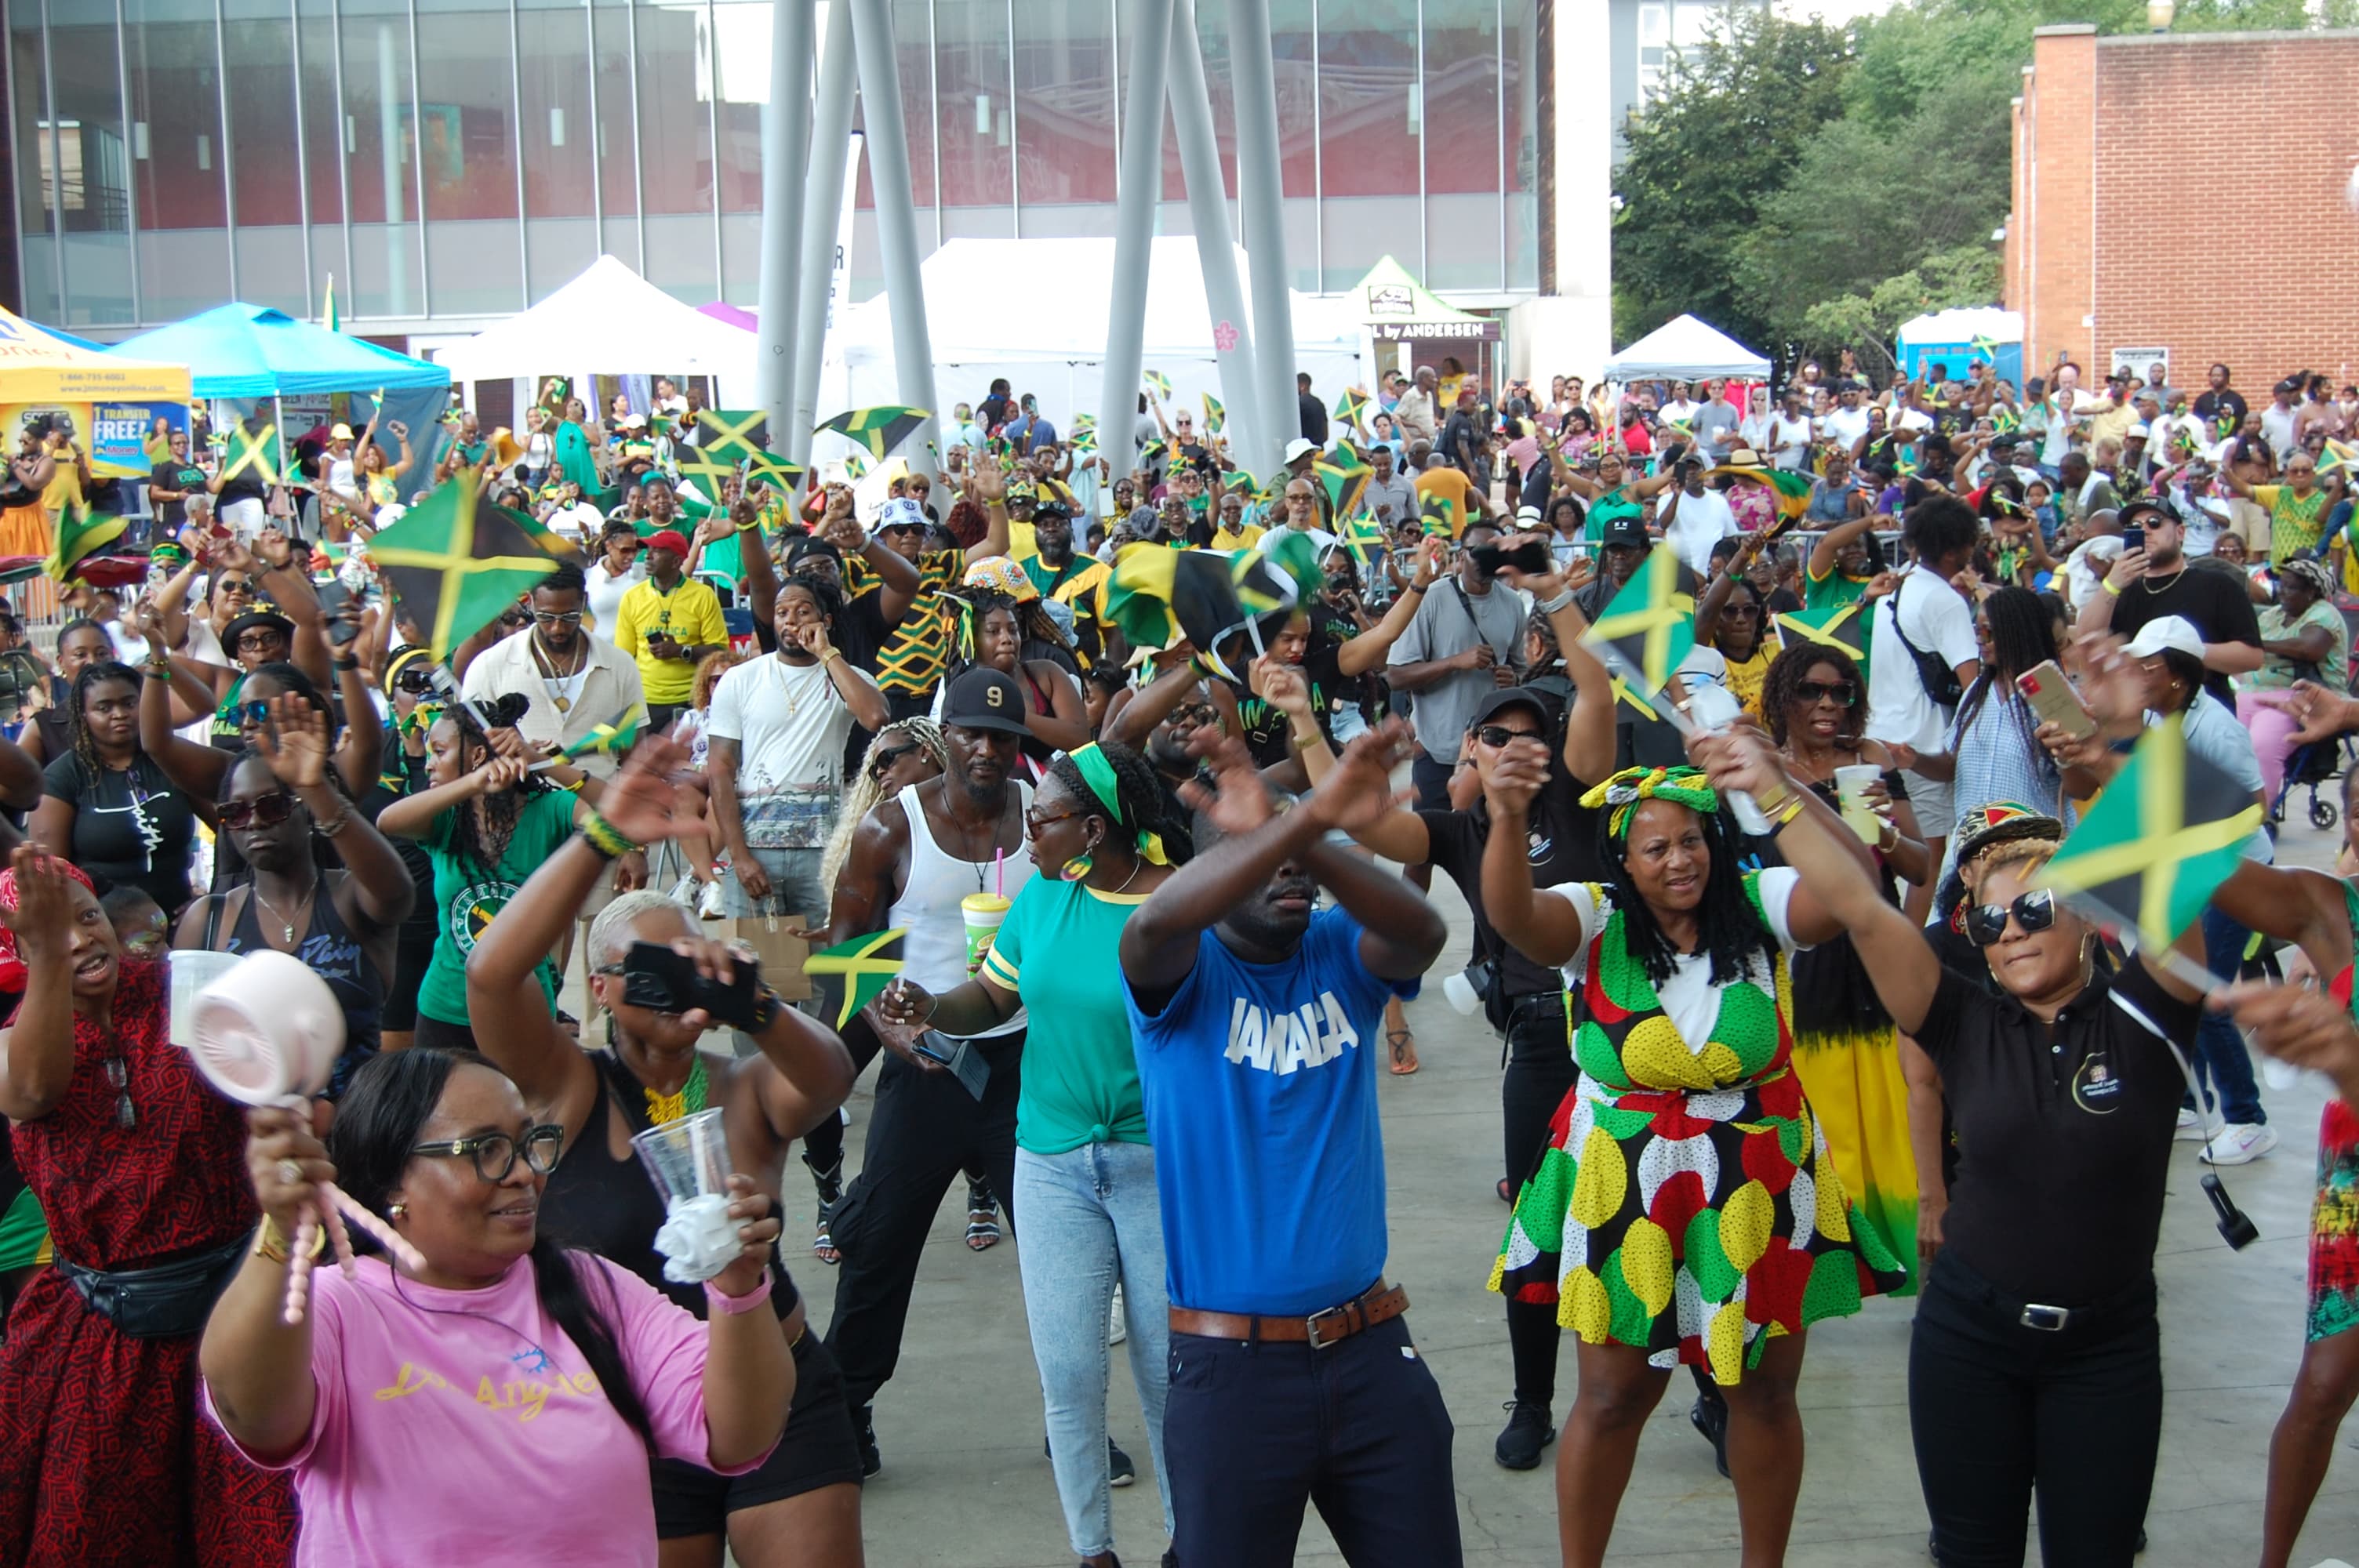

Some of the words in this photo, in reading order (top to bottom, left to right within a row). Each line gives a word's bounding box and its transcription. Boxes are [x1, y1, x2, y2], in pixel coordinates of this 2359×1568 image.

[1384, 325, 1401, 340] by
[1402, 323, 1485, 339] ANDERSEN
[104, 408, 151, 420] TRANSFER
[93, 421, 147, 440] FREE!
[987, 685, 1003, 707] 9
[1223, 991, 1359, 1076] JAMAICA
